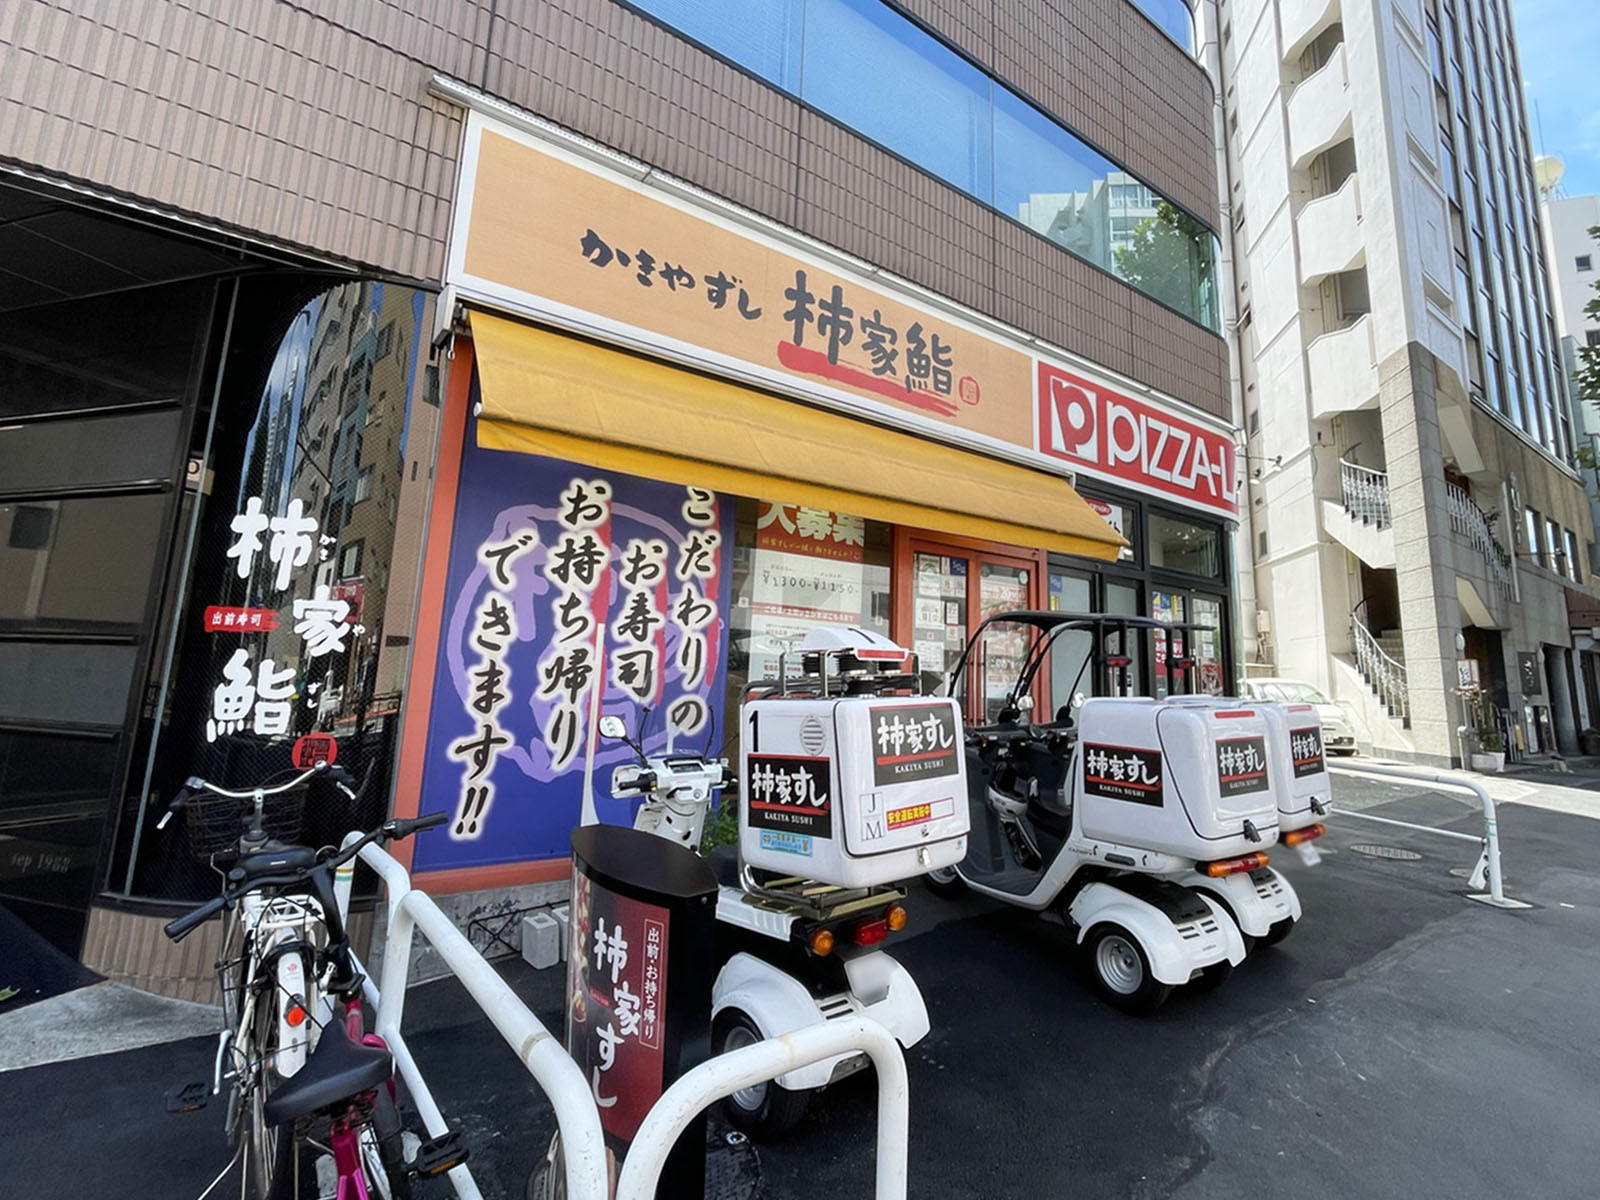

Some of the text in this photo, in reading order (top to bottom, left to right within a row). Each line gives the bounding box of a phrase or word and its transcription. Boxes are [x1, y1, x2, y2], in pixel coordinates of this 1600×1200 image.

[783, 270, 953, 396] 柿家鮨
[211, 610, 262, 627] 出前寿司
[542, 484, 607, 766] お持ち帰り
[617, 543, 664, 698] お寿司
[671, 486, 716, 731] こだわりの
[749, 710, 759, 752] 1
[877, 712, 954, 756] 柿家すし
[895, 759, 944, 774] KAKIYA SUSHI
[1087, 749, 1159, 785] 柿家すし
[1220, 744, 1264, 776] 柿家すし
[752, 763, 828, 807] 柿家すし
[764, 811, 813, 826] KAKIYA SUSHI
[592, 917, 641, 1108] 柿家すし
